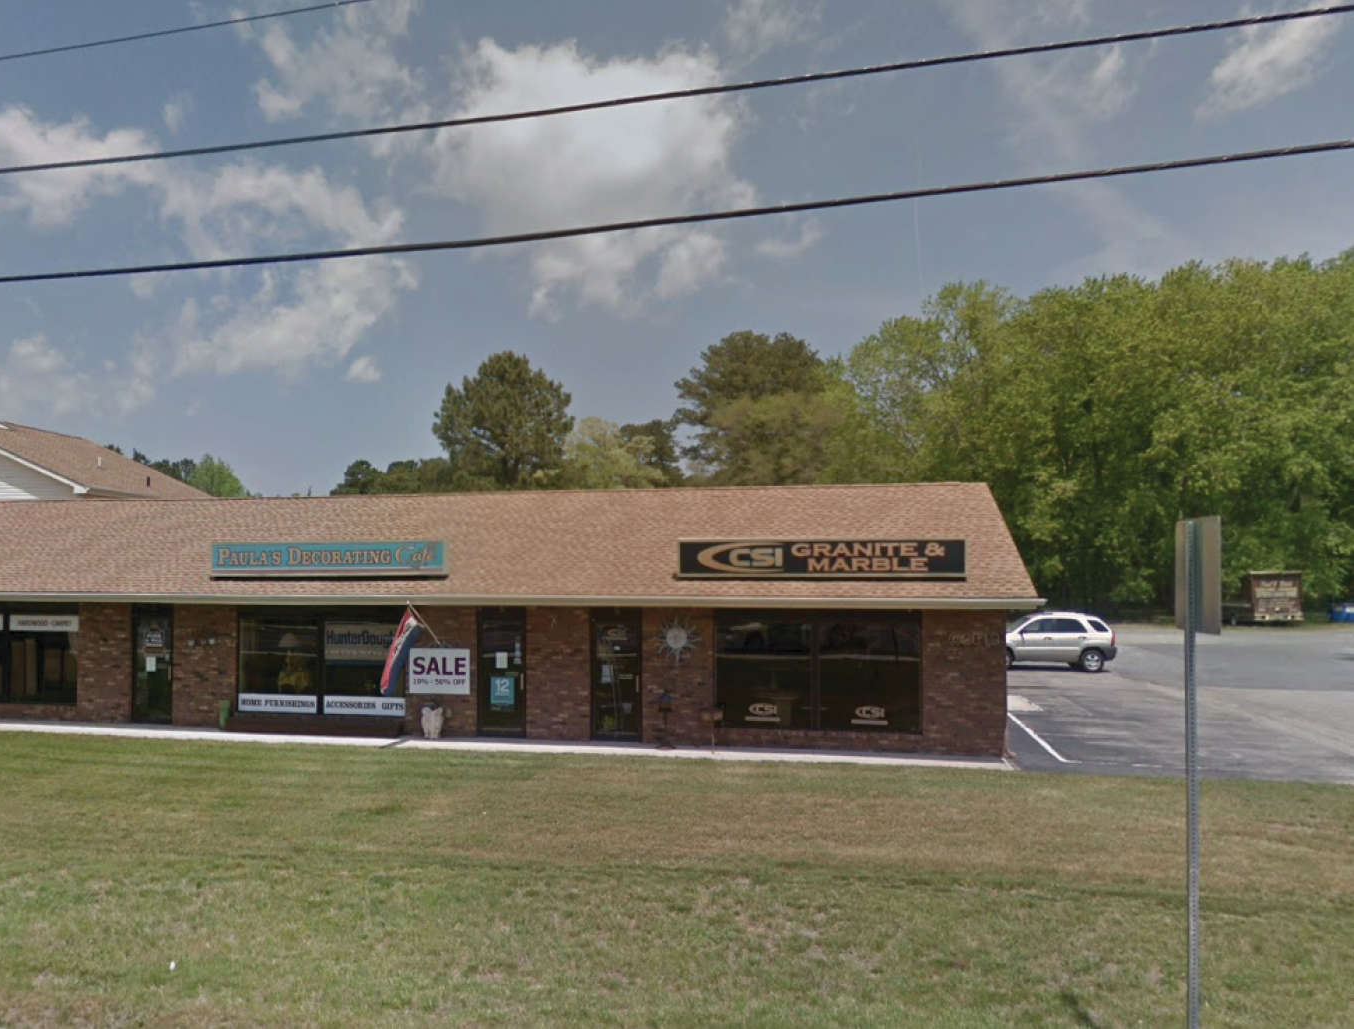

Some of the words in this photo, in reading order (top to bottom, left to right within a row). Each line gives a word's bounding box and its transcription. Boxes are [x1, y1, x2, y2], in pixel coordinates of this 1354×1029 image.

[217, 548, 282, 566] PAULA'S
[288, 547, 391, 566] DECORATING
[791, 542, 918, 557] GRANITE
[924, 542, 945, 557] &
[728, 548, 784, 568] CSI
[807, 557, 930, 573] MARBLE
[412, 656, 467, 675] SALE
[495, 679, 510, 692] 12
[264, 699, 316, 708] FURNISHINGS
[326, 700, 377, 709] ACCESSORIES
[381, 702, 404, 711] GIFTS
